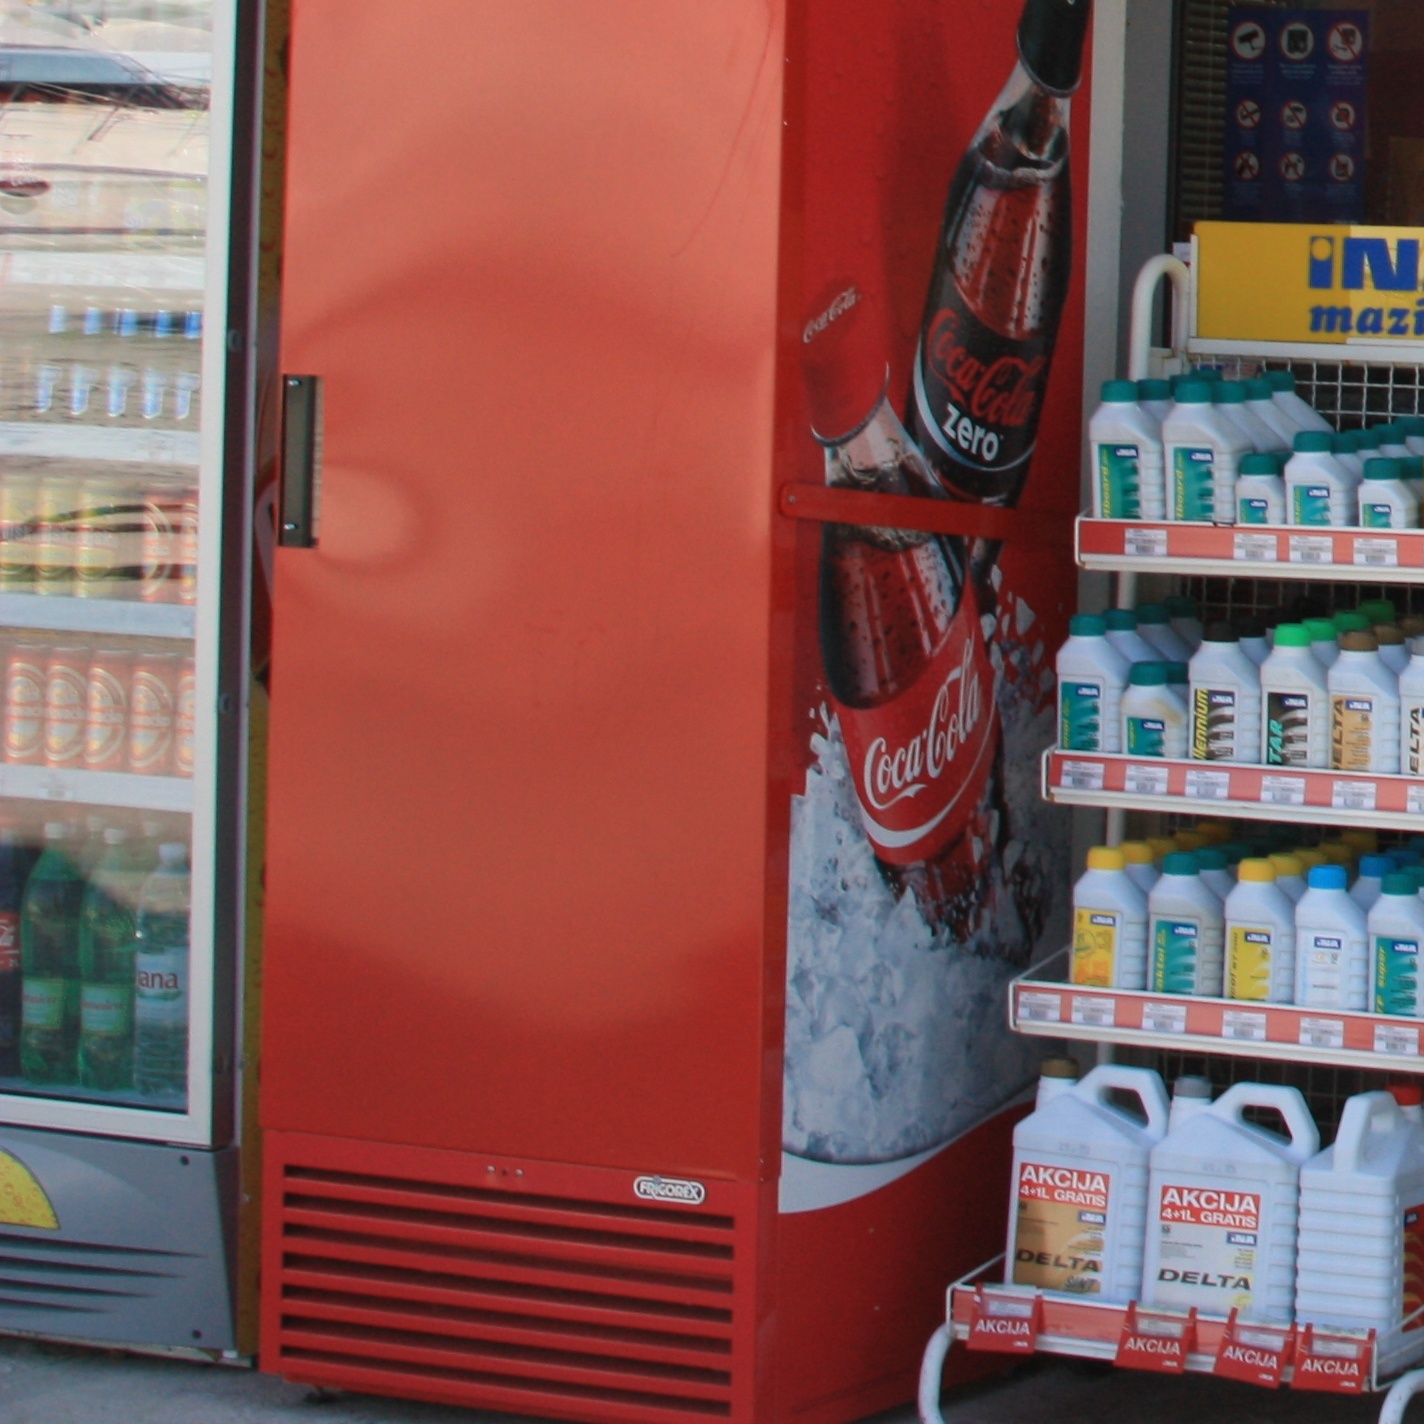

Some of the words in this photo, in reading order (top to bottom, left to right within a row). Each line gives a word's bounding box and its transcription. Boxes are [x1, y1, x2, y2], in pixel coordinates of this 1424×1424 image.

[942, 402, 1001, 462] zero
[863, 638, 982, 811] Coca-Cola
[1021, 1164, 1107, 1194] AKCIJA
[1054, 1189, 1106, 1207] GRATIS
[1163, 1187, 1258, 1215] AKCIJA
[1200, 1211, 1257, 1228] GRATIS
[1016, 1249, 1100, 1273] DELTA
[1158, 1268, 1252, 1291] DELTA
[975, 1318, 1031, 1336] AKCIJA
[1124, 1337, 1181, 1355] AKCIJA
[1223, 1345, 1278, 1370] AKCIJA
[1301, 1358, 1360, 1376] AKCIJA
